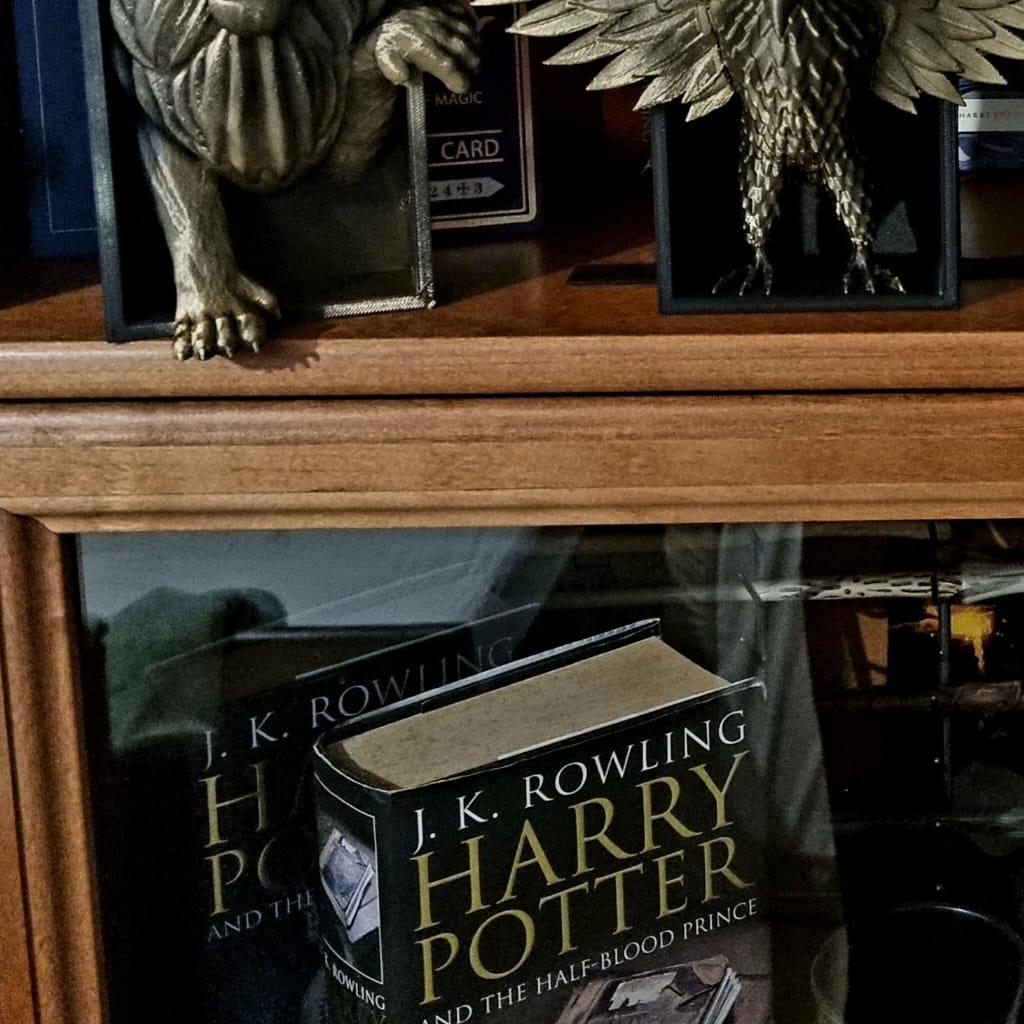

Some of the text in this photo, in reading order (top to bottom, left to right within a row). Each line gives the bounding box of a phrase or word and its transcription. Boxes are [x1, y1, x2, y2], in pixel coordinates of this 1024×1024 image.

[434, 90, 484, 106] MAGIC
[440, 138, 500, 160] CARD
[203, 731, 227, 771] J.
[250, 711, 289, 749] K.
[413, 709, 747, 856] J. K. ROWLING
[410, 750, 750, 932] HARRY
[206, 909, 263, 943] AND
[415, 835, 755, 1006] POTTER
[481, 982, 528, 1014] THE
[536, 929, 676, 996] HALF-BLOOD
[682, 898, 758, 941] PRINCE
